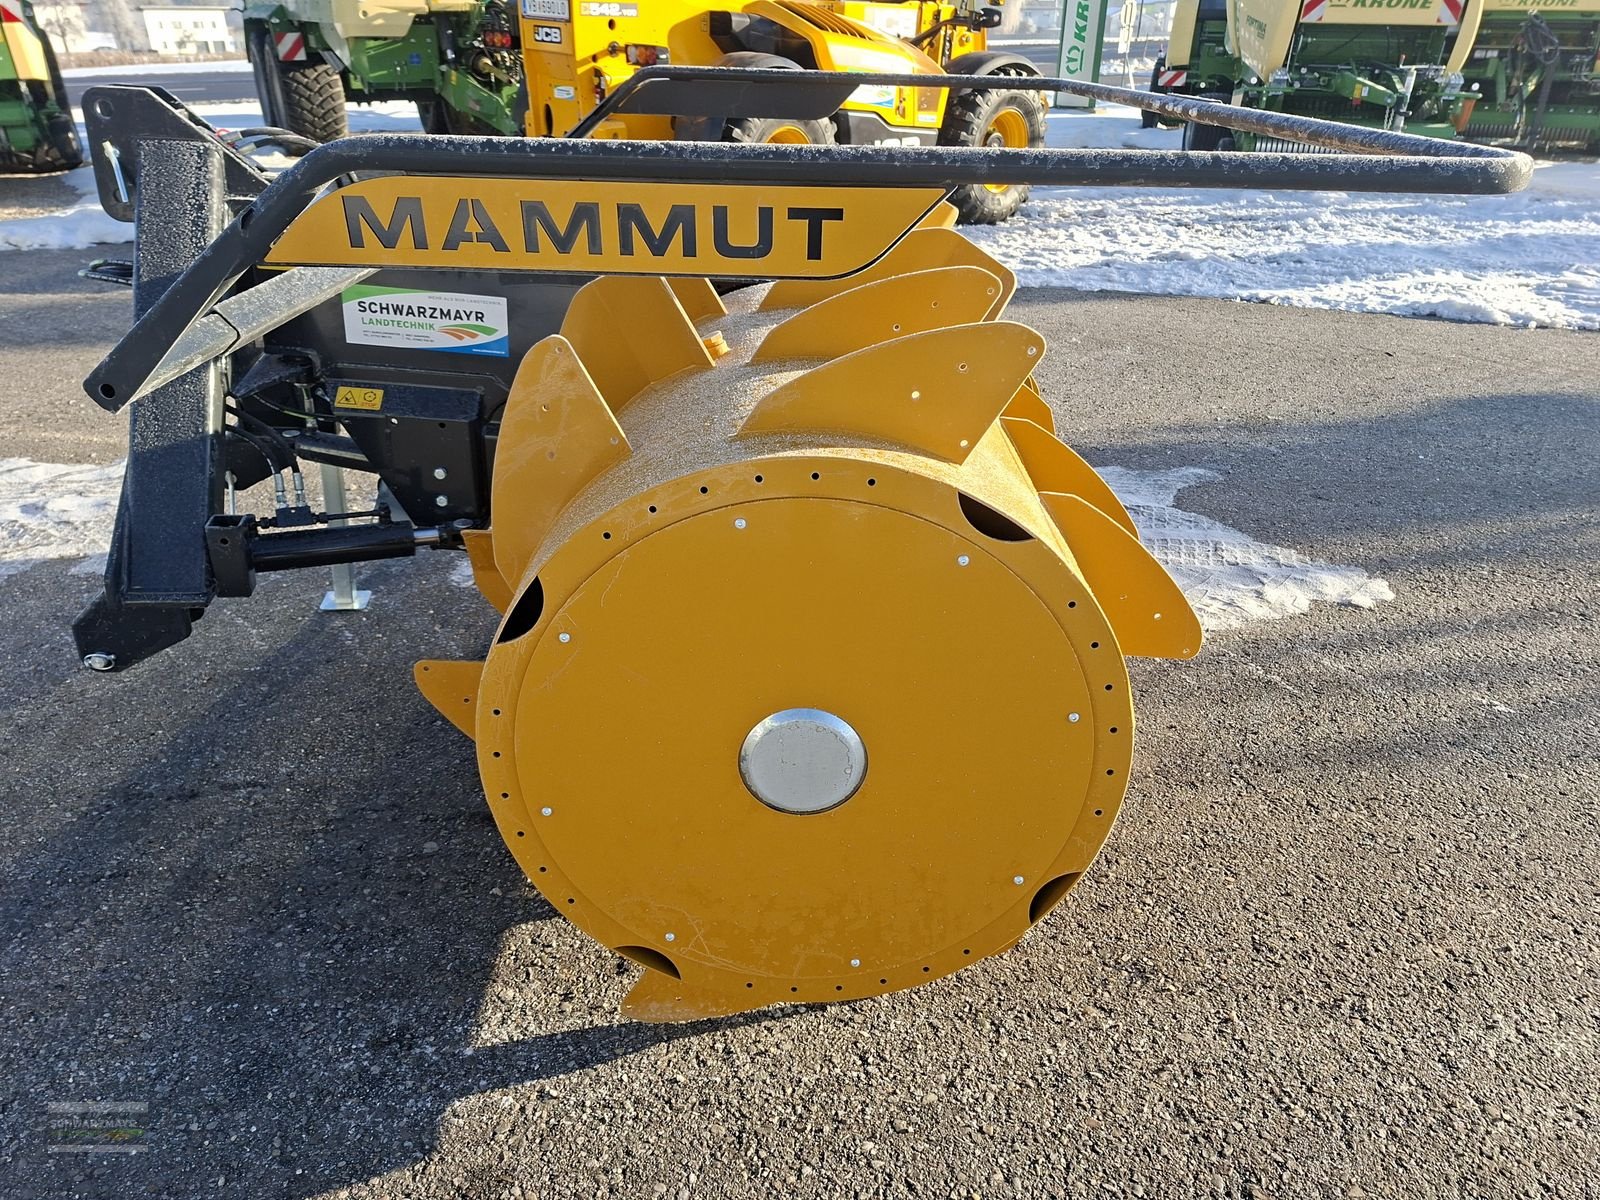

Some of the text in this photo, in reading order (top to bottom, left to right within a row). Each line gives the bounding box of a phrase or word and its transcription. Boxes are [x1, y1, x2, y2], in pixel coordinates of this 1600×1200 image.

[534, 27, 561, 43] JCB
[341, 194, 844, 261] MAMMUT
[357, 300, 485, 323] SCHWARZMAYR
[361, 317, 436, 331] LANDTECHNIK
